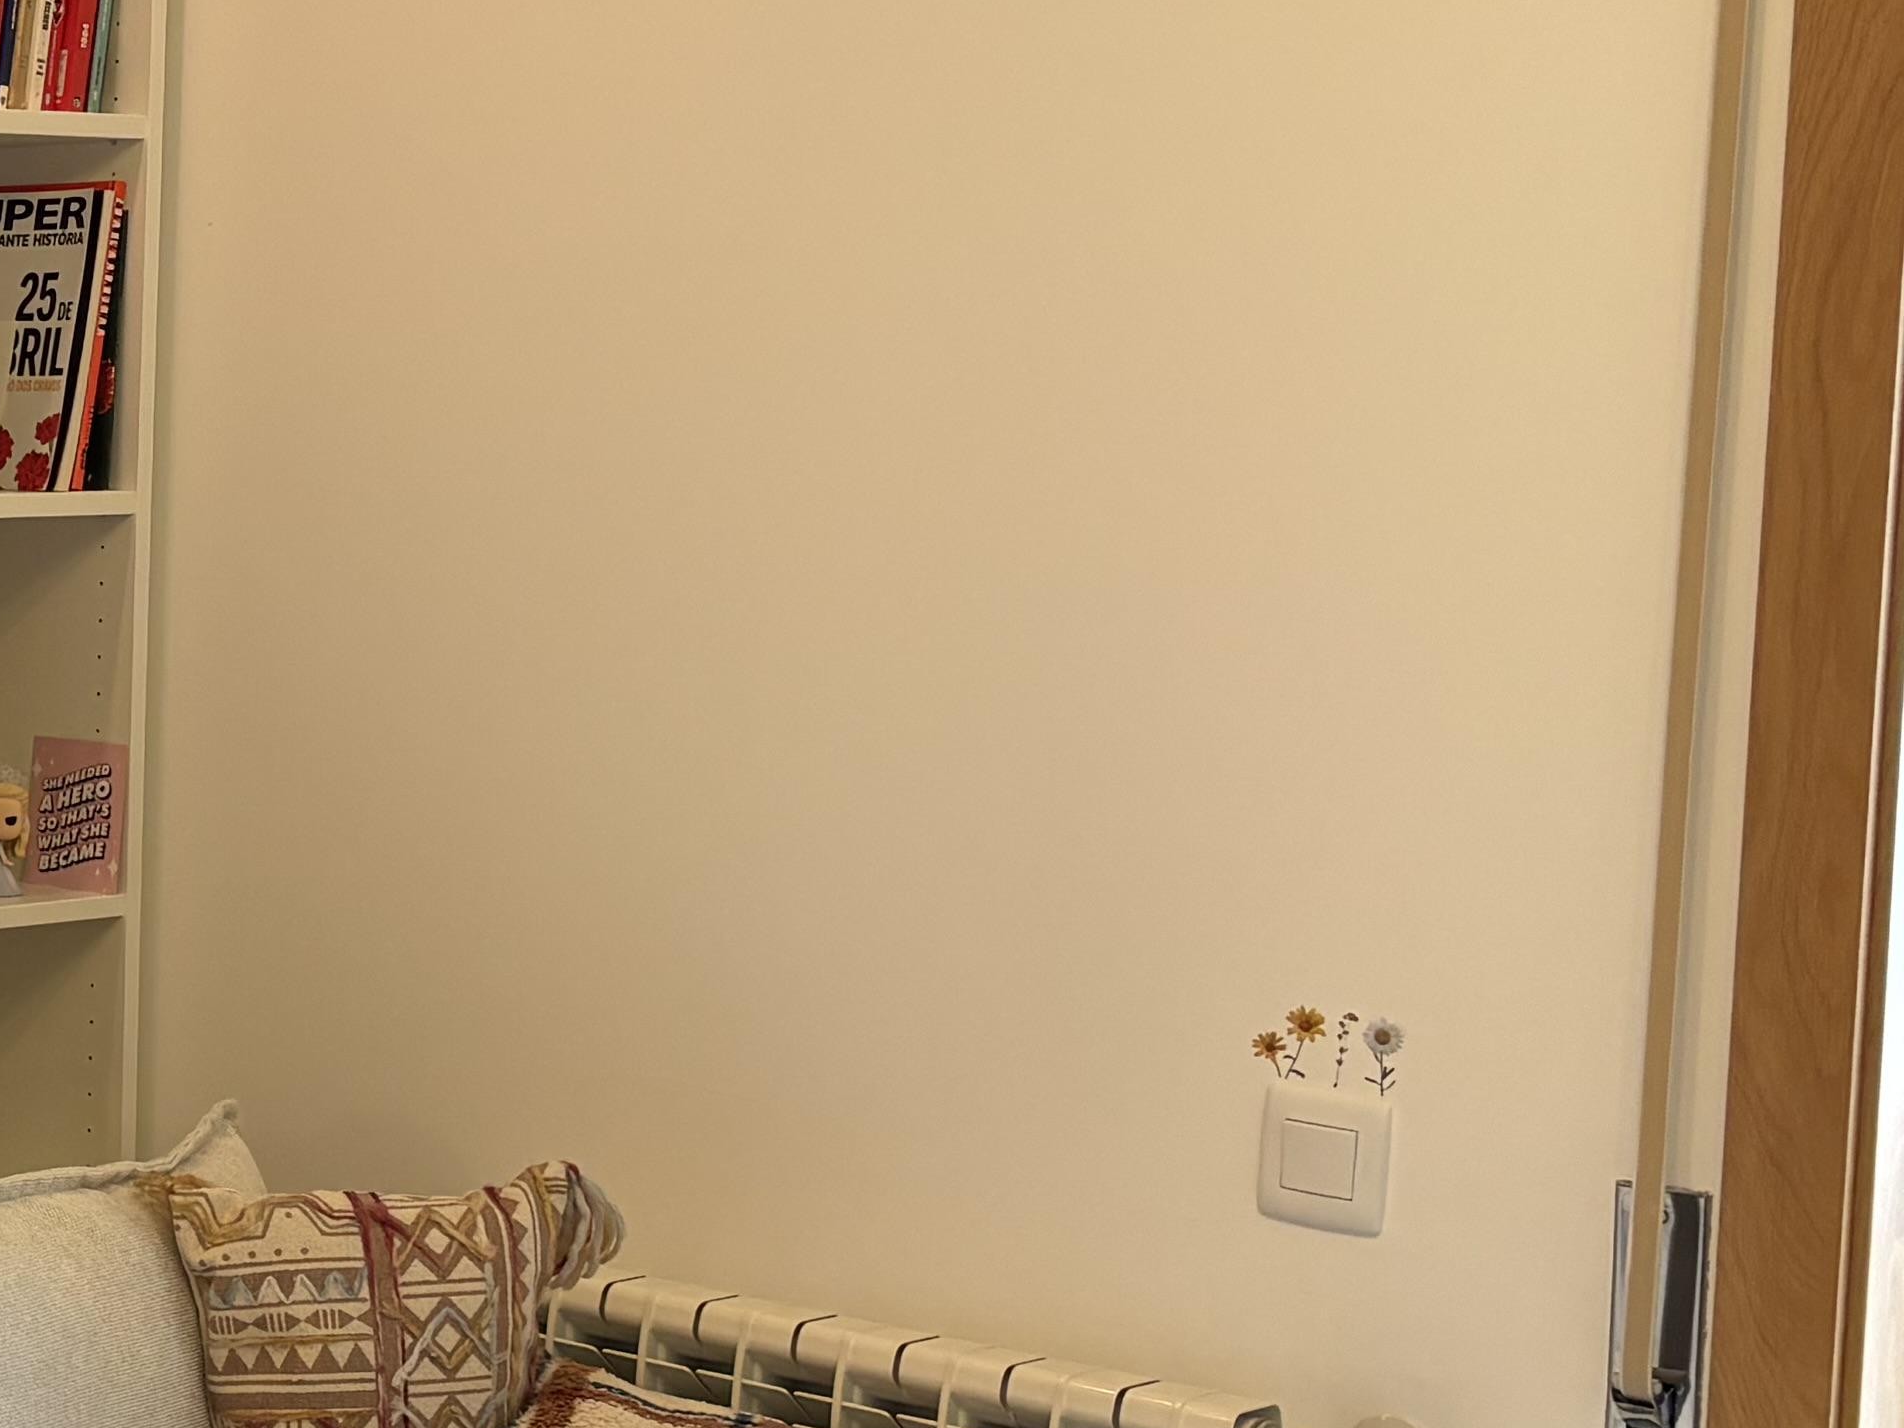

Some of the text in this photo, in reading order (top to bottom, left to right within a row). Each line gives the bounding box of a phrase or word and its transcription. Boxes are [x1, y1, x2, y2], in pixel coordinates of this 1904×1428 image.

[15, 271, 73, 323] 25 DE
[9, 327, 64, 377] RIL
[39, 780, 112, 813] A HERO
[38, 841, 106, 872] BECAME
